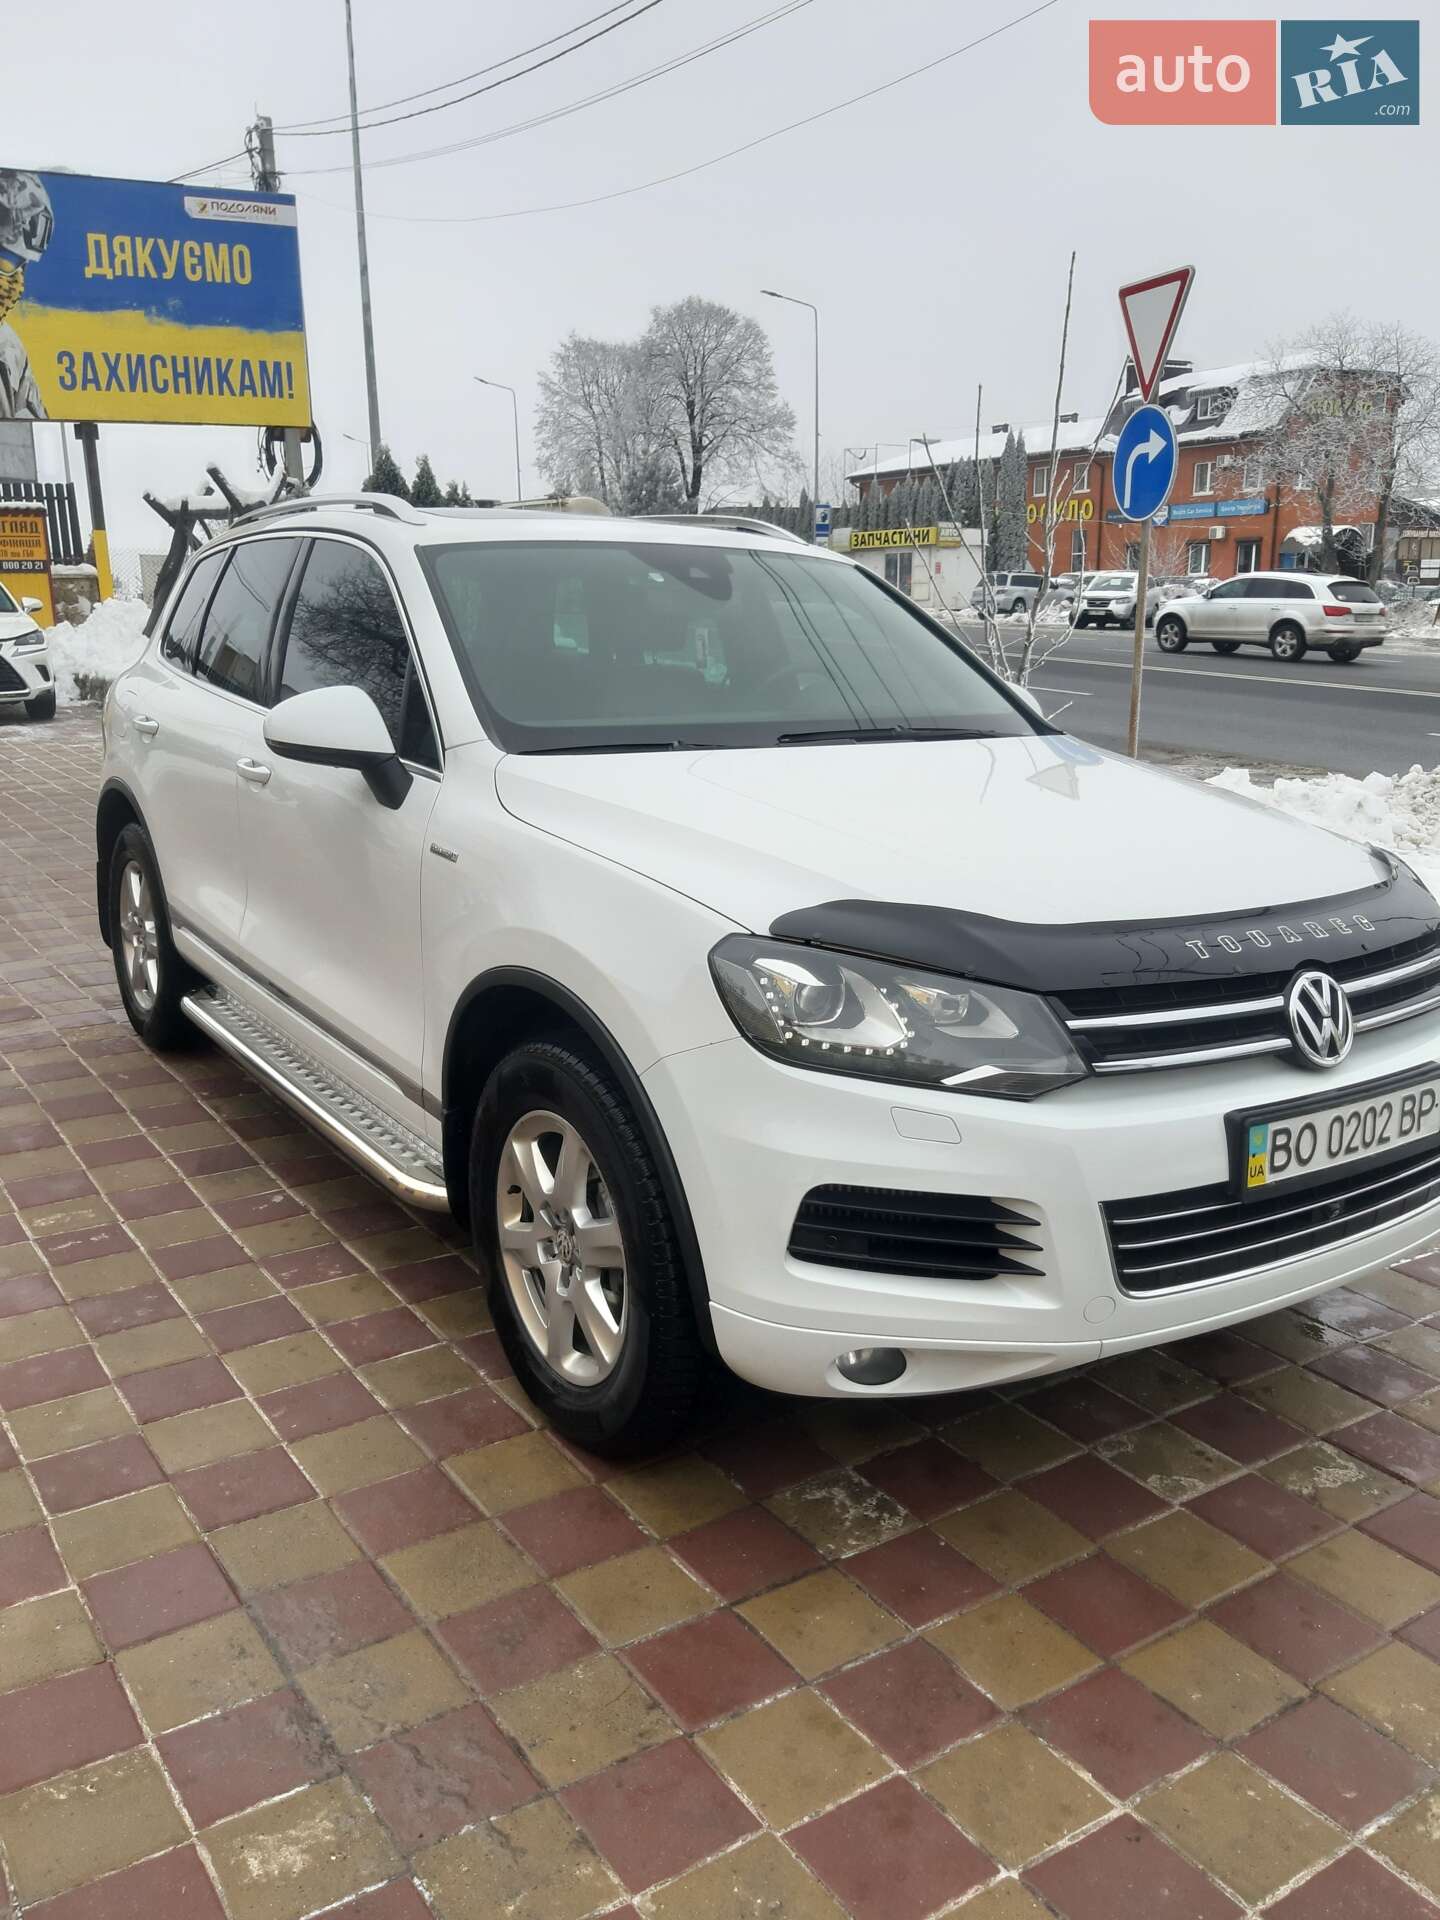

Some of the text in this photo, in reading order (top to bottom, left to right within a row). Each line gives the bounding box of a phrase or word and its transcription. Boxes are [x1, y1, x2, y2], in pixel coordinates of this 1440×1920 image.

[84, 232, 252, 285] ДЯКУЄМО
[56, 350, 294, 399] ЗАХИСНИКАМ!
[853, 528, 930, 547] ЗАПЧАСТИНИ
[21, 561, 33, 570] 20
[34, 561, 43, 570] 21
[1185, 914, 1375, 959] TOUAREG
[1270, 1087, 1436, 1175] BO 0202 BP
[1249, 1163, 1265, 1178] UA
